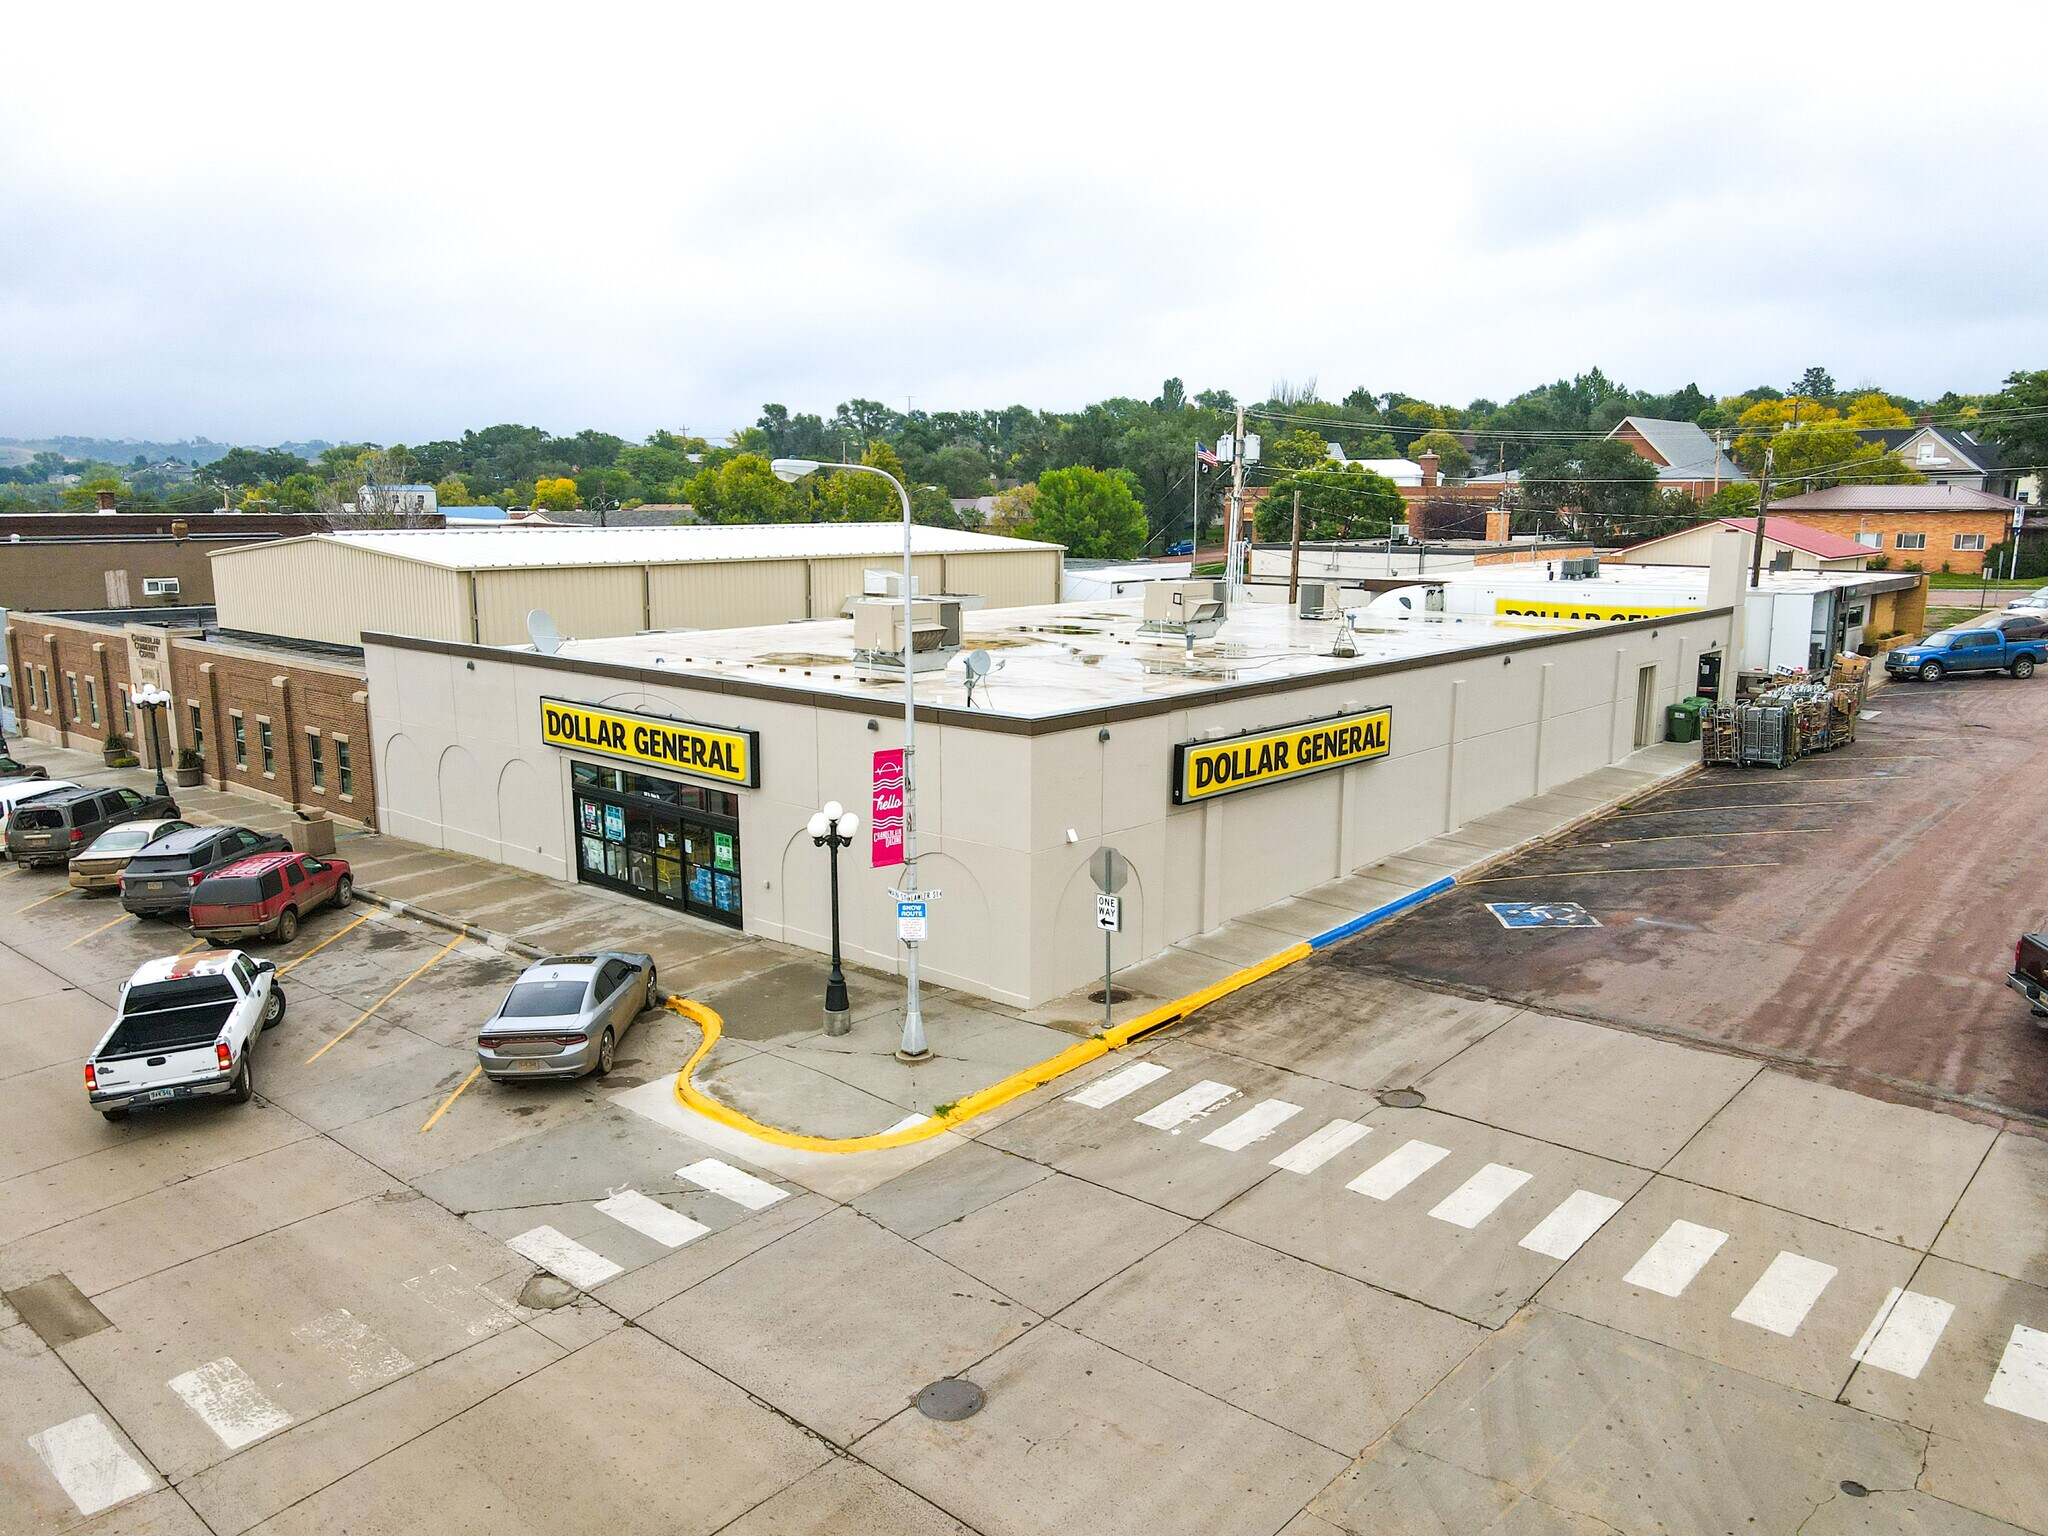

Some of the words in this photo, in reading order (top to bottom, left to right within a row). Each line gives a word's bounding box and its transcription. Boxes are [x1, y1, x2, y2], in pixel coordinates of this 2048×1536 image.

[546, 710, 627, 750] DOLLAR
[634, 727, 739, 773] GENERAL
[1196, 741, 1289, 789] DOLLAR
[1297, 721, 1386, 766] GENERAL
[873, 794, 902, 811] hello
[1099, 897, 1115, 908] ONE
[1099, 907, 1115, 917] WAY
